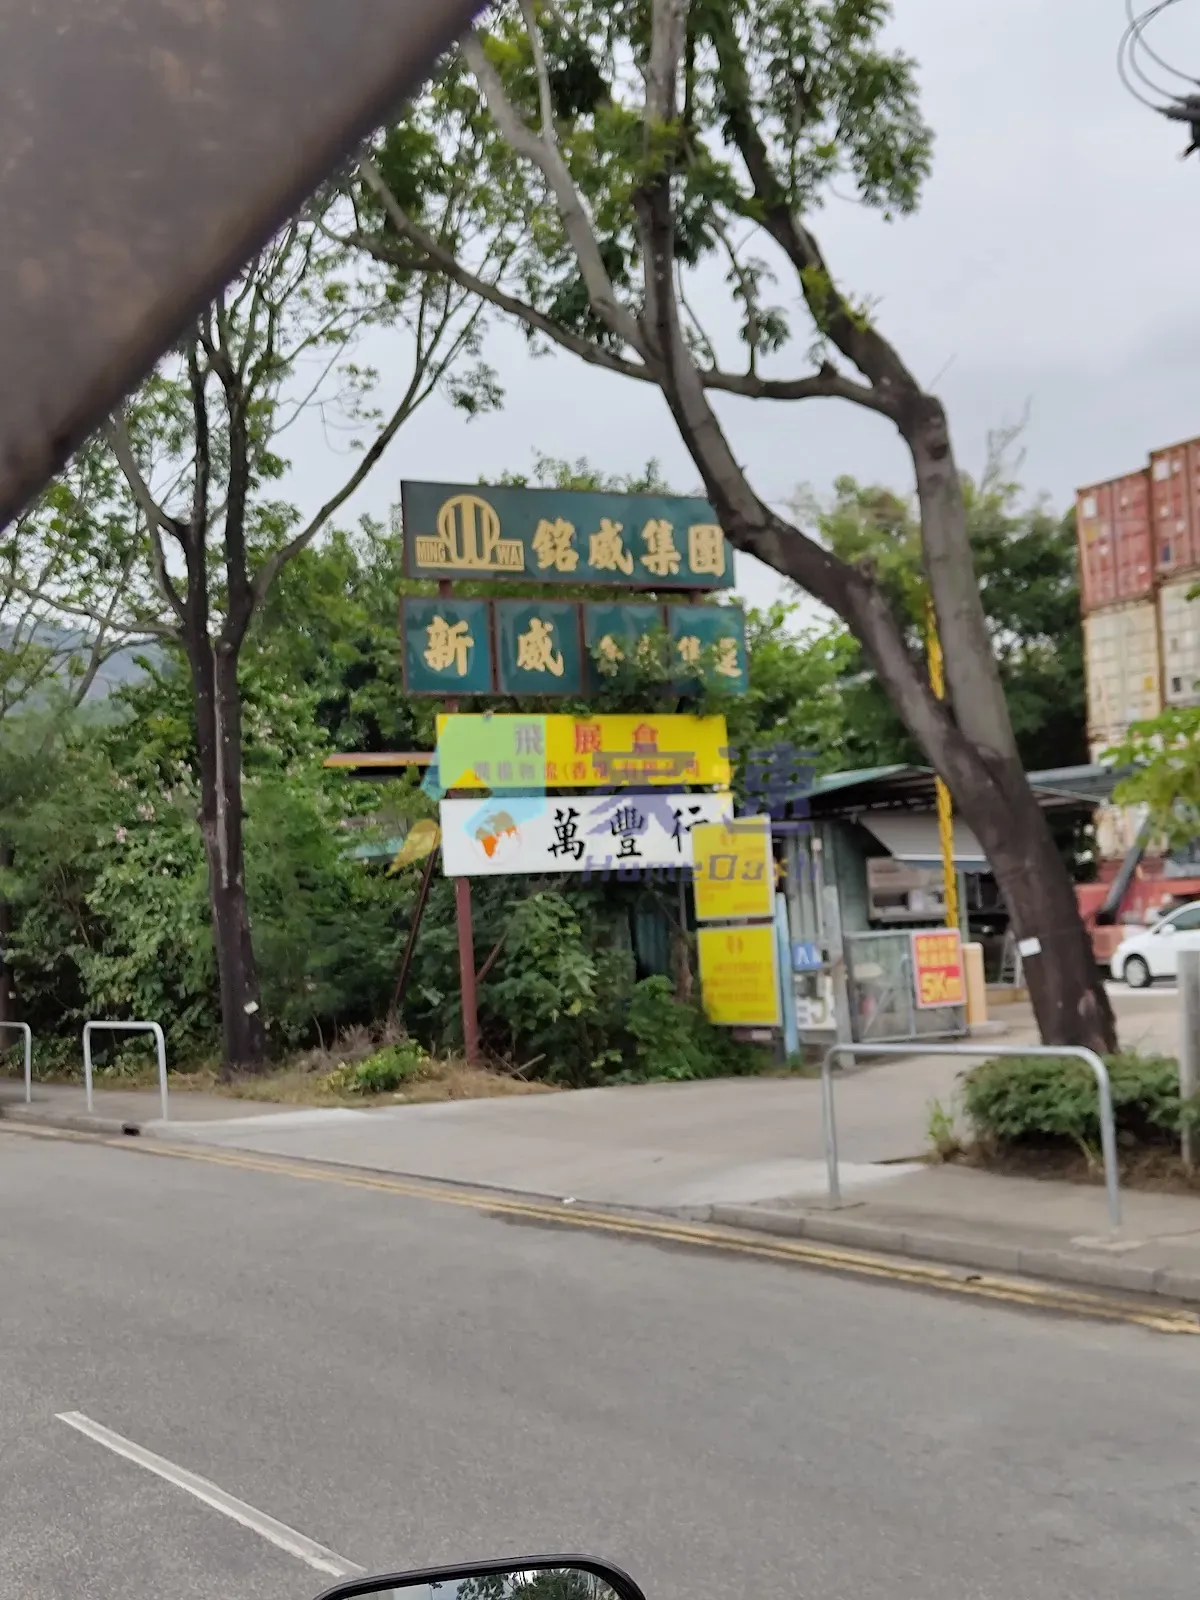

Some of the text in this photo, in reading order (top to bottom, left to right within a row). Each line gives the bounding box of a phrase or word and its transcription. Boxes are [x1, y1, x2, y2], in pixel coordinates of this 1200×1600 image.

[531, 515, 726, 577] 銘威集團
[423, 614, 565, 678] 新威
